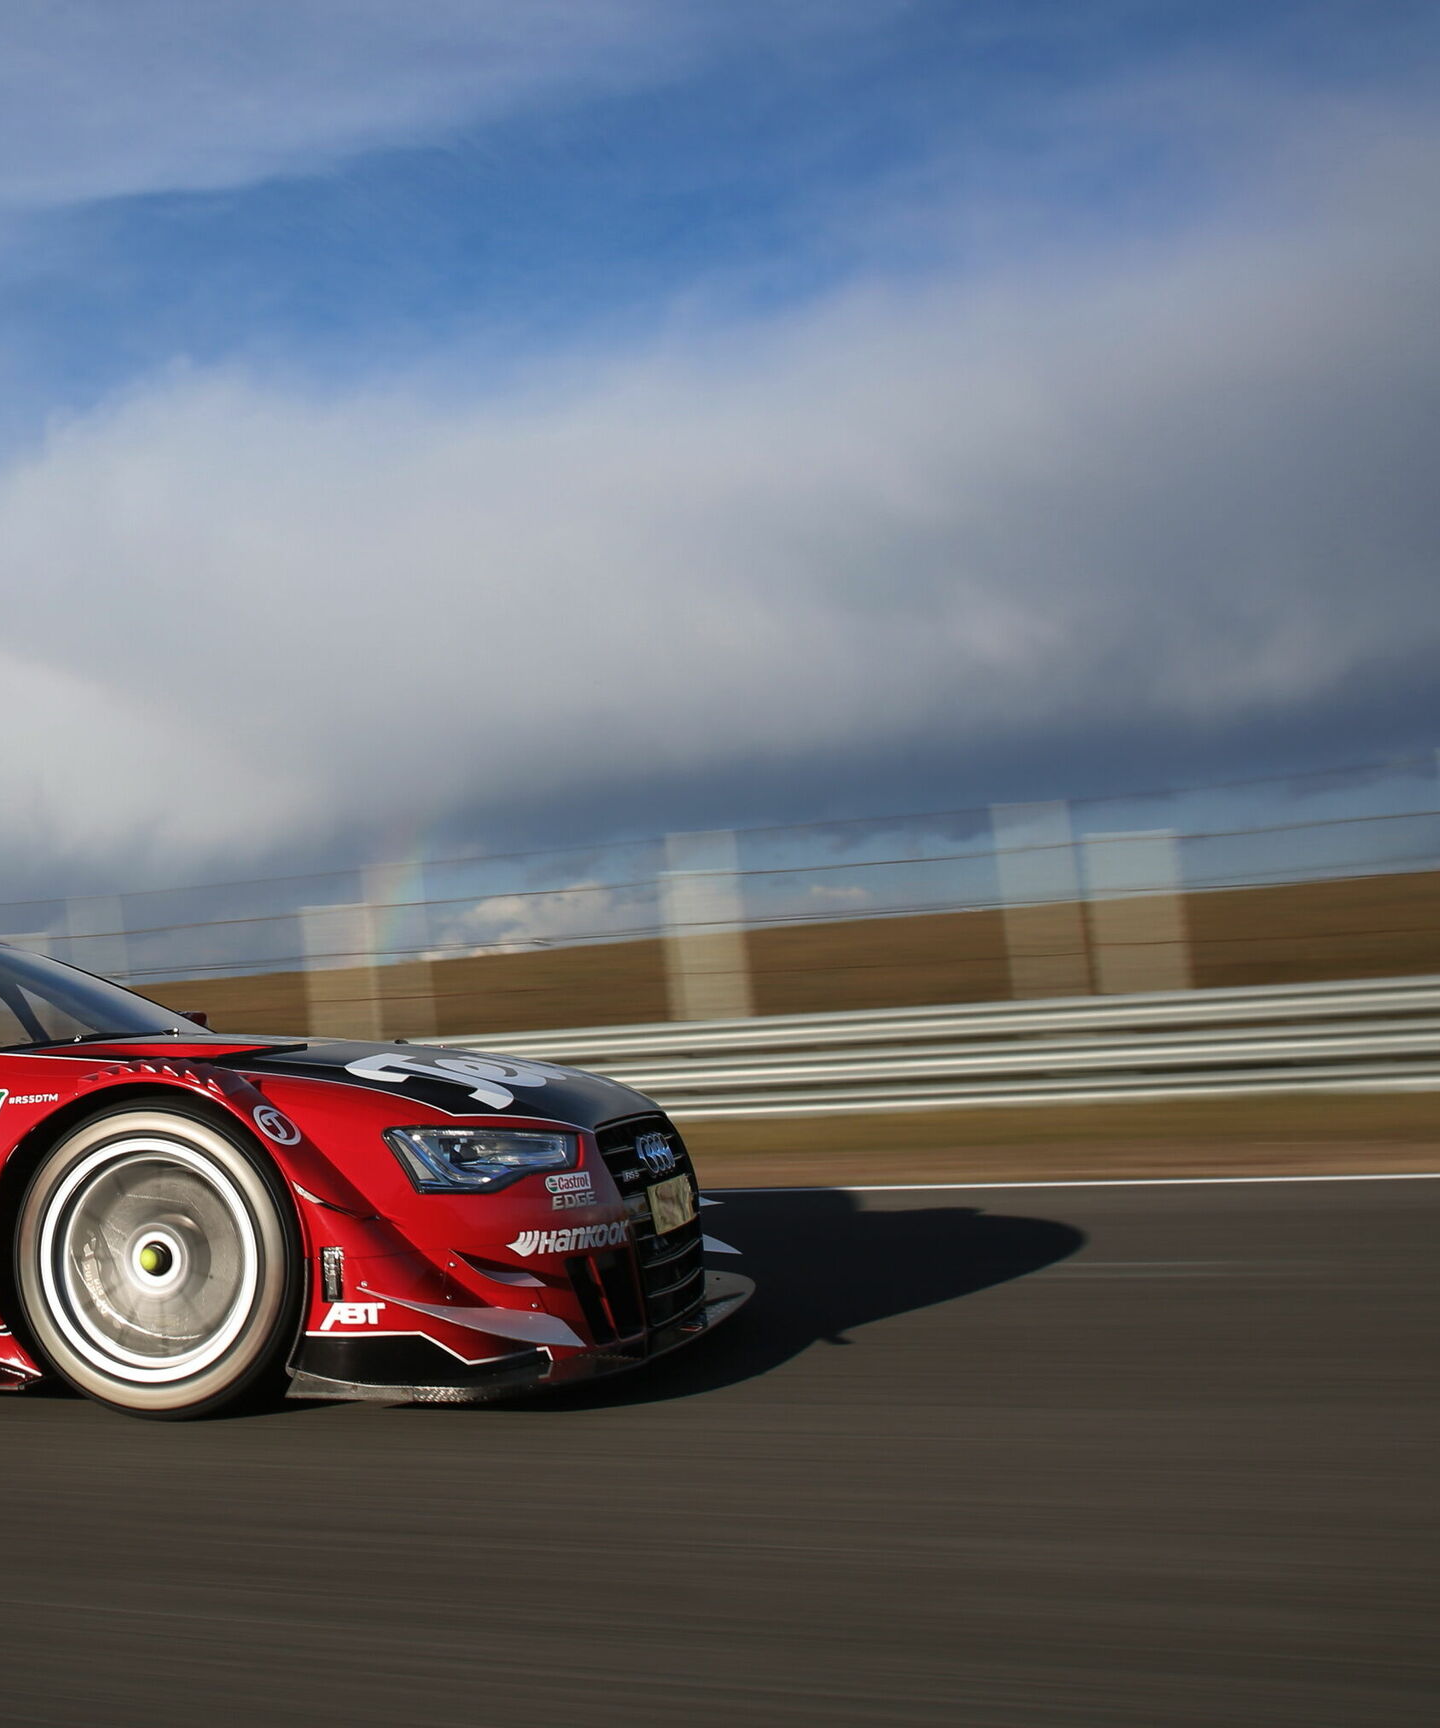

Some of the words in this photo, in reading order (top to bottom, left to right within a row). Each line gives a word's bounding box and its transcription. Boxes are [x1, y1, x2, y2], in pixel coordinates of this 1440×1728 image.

[557, 1174, 590, 1190] Castrol
[551, 1191, 598, 1211] EDGE
[319, 1302, 386, 1331] ABT
